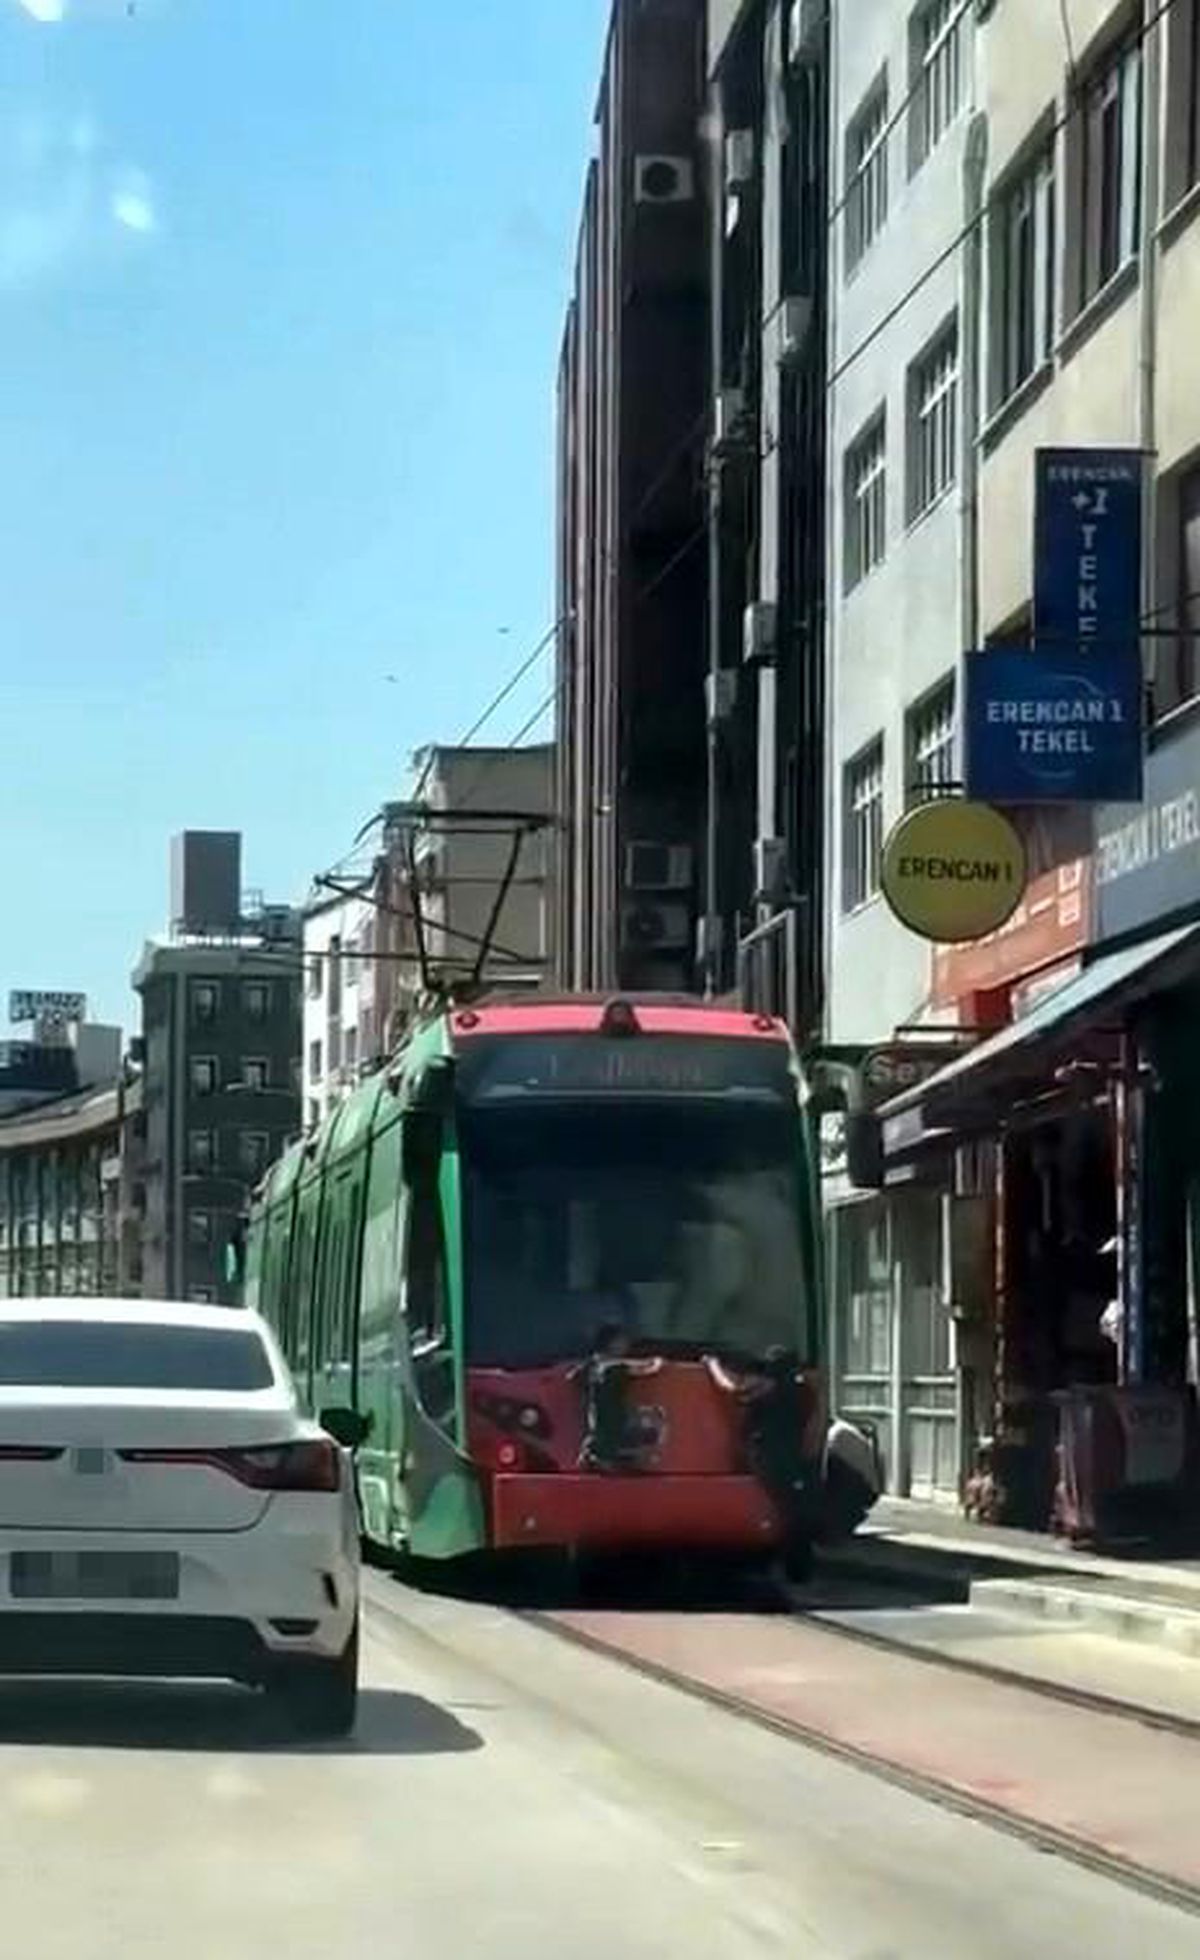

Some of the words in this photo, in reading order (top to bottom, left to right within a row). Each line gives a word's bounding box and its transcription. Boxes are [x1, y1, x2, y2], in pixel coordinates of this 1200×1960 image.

[1078, 524, 1098, 653] TEKE
[986, 700, 1104, 723] ERENCAN
[1110, 701, 1125, 723] 1
[1017, 730, 1095, 753] TEKEL
[899, 857, 1000, 882] ERENCAN
